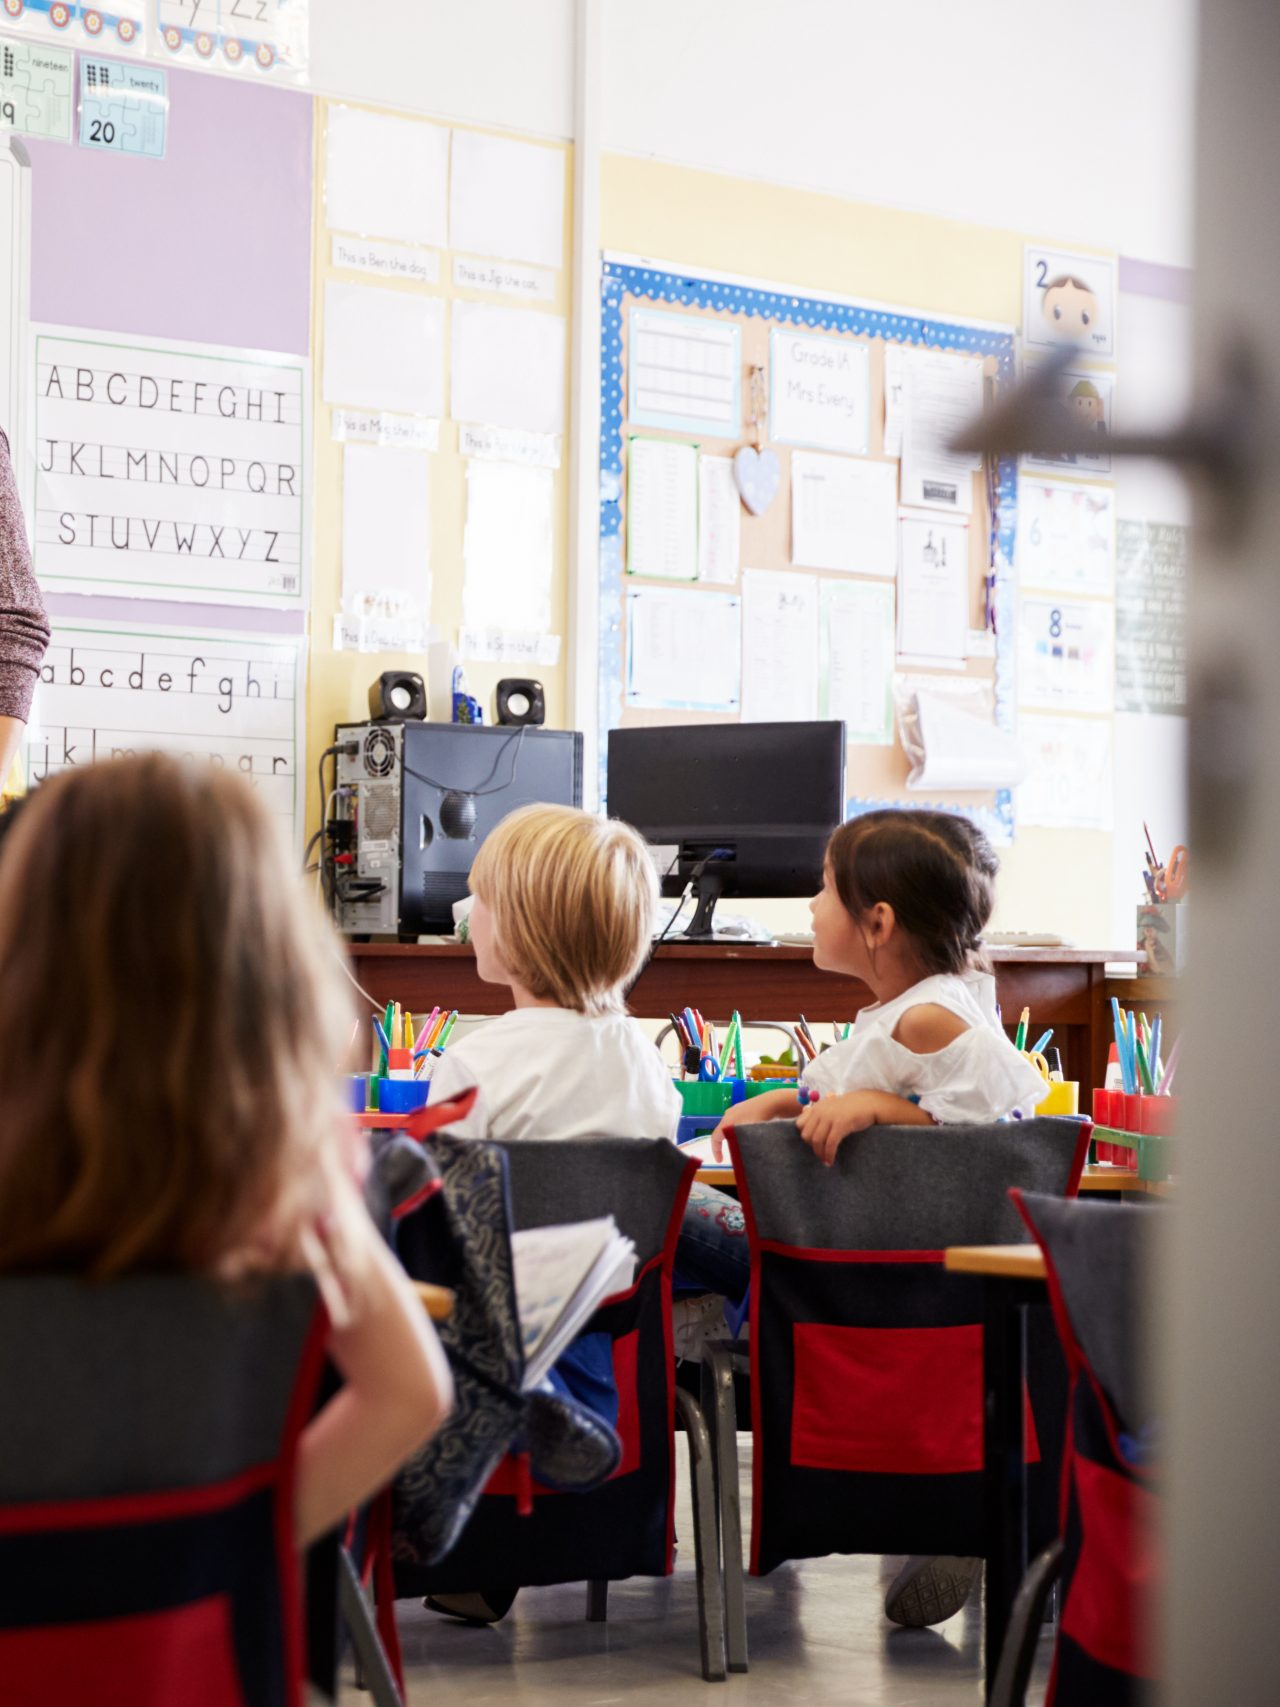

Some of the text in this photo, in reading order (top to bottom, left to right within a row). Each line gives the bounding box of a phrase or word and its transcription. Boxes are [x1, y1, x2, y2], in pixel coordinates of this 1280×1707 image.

[32, 58, 69, 73] nineteen
[130, 77, 160, 92] twenty
[89, 119, 116, 145] 20
[338, 247, 356, 263] This
[458, 265, 476, 281] This
[1036, 260, 1048, 288] 2
[791, 342, 834, 368] Grade
[787, 380, 814, 403] Mrs
[1030, 518, 1041, 546] 6
[1050, 609, 1062, 638] 8
